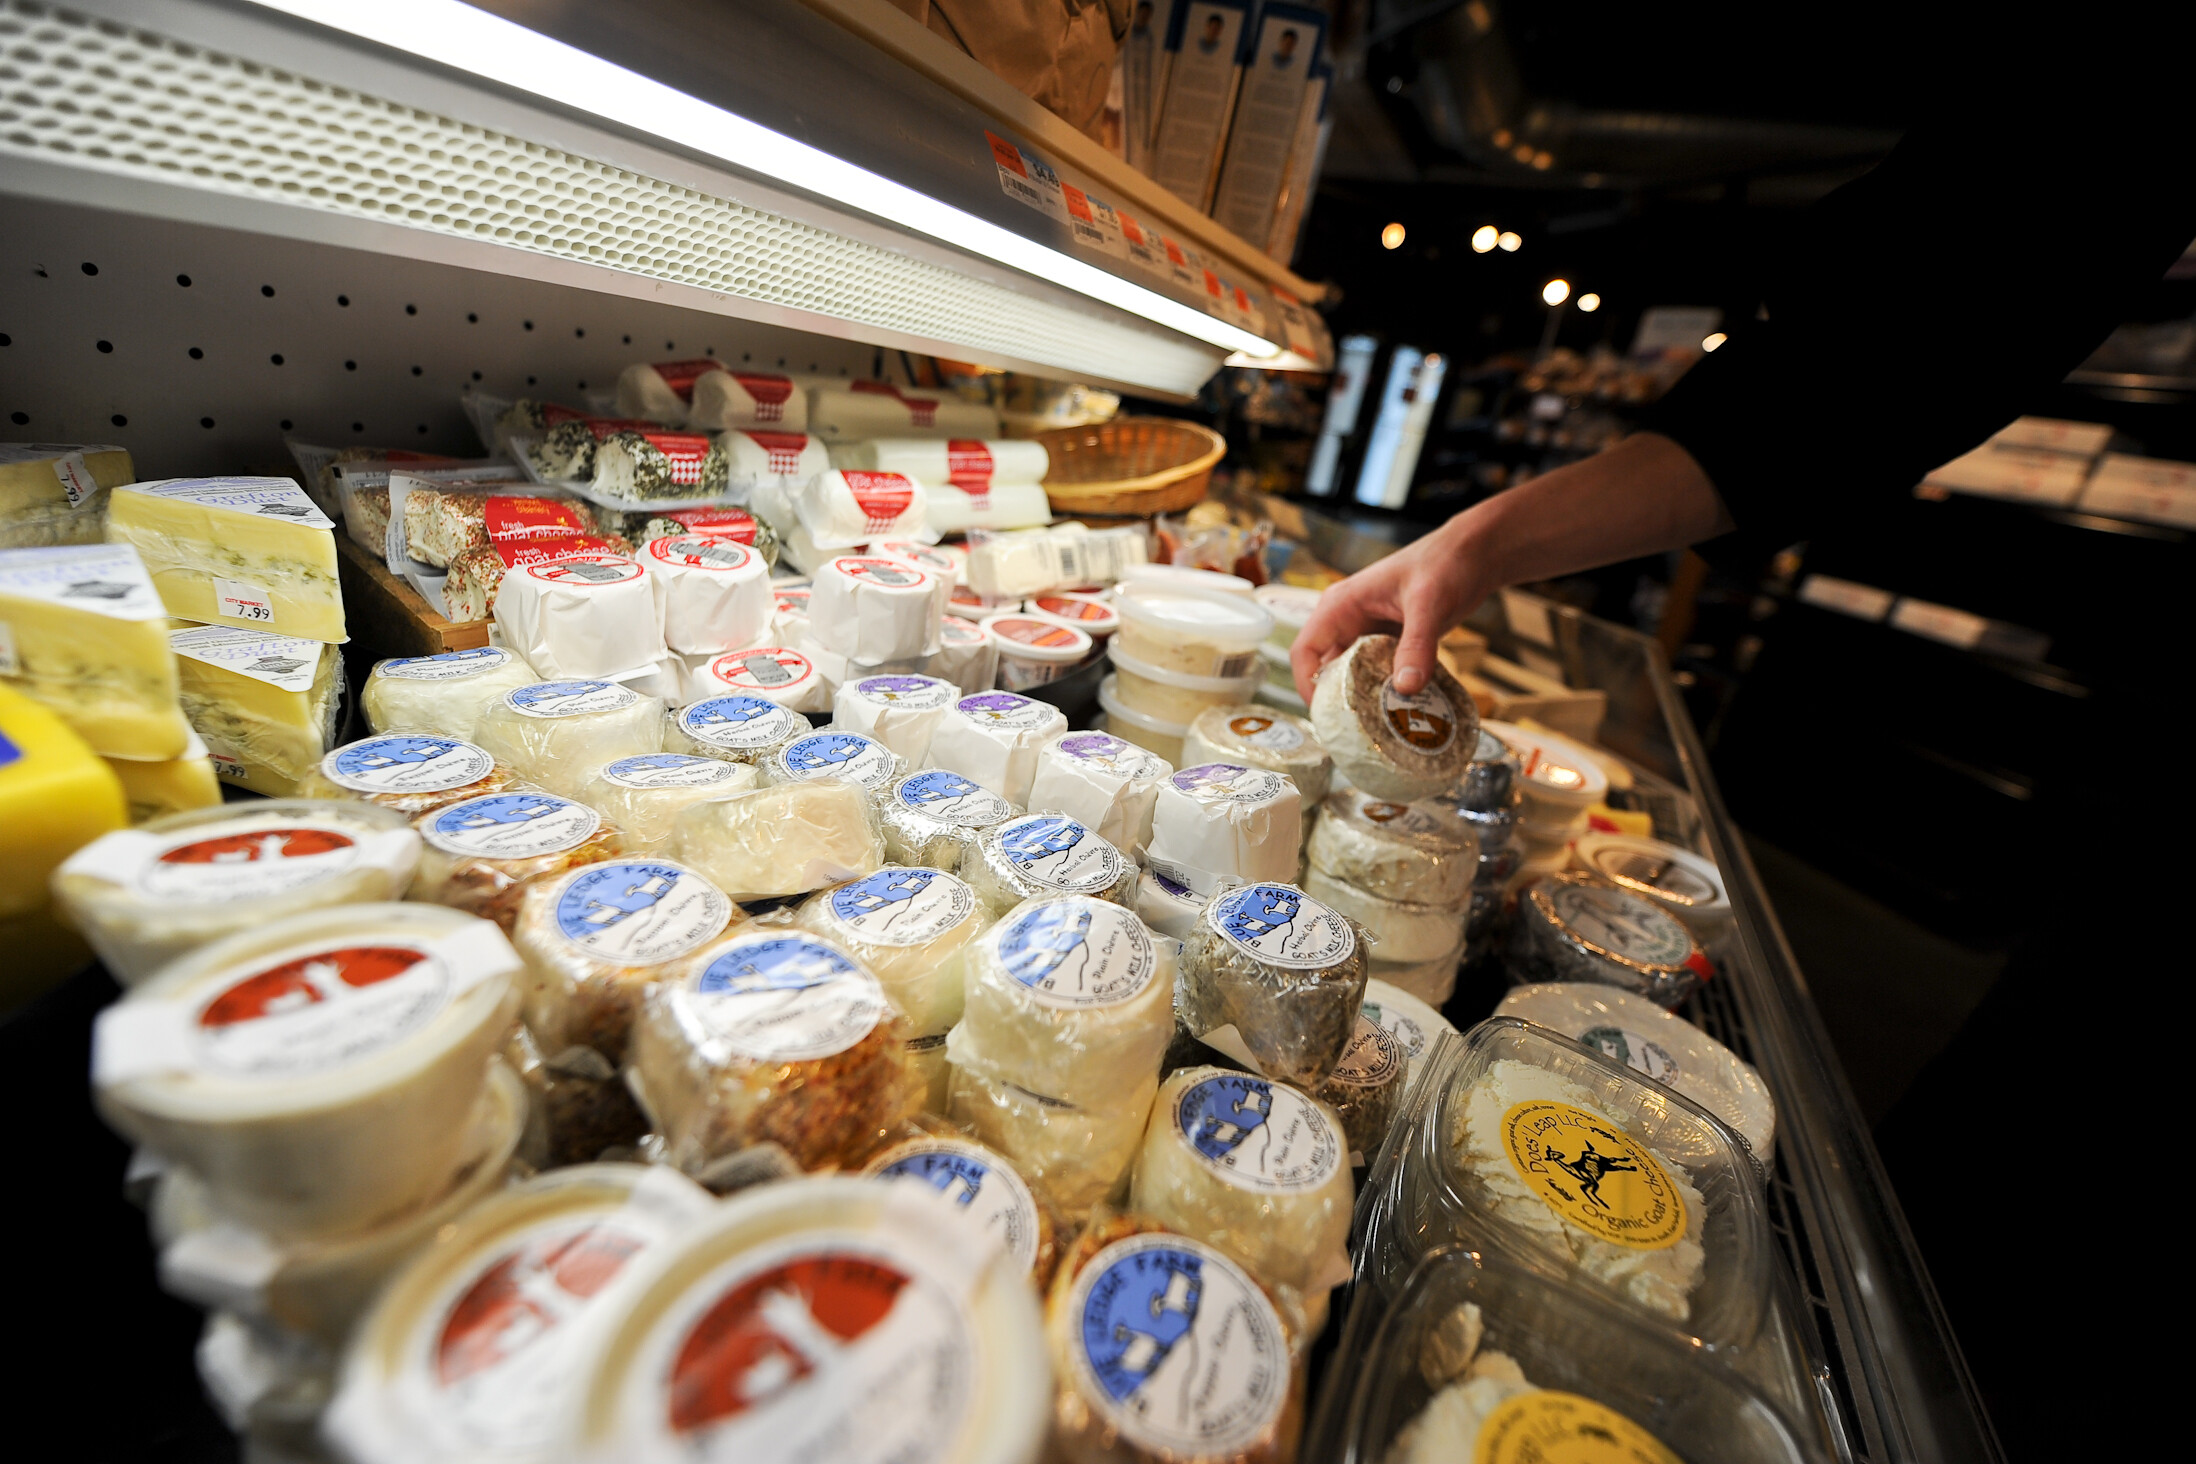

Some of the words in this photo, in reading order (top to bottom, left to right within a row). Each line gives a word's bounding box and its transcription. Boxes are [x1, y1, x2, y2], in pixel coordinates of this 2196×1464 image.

[60, 474, 80, 503] 7.99
[195, 490, 302, 504] Grafton
[220, 496, 290, 506] Duet
[501, 520, 525, 531] fresh
[515, 547, 541, 558] fresh
[555, 546, 610, 560] cheese
[237, 604, 270, 620] 7.99
[239, 599, 264, 607] MARKET
[199, 640, 318, 658] Grafton
[220, 647, 298, 660] Duet
[698, 698, 734, 712] LEDGE
[716, 735, 748, 743] GOAT'S
[750, 734, 768, 742] MILK
[791, 737, 825, 755] LEDGE
[832, 736, 867, 749] FARM
[346, 739, 392, 759] LEDGE
[214, 761, 246, 777] 7.99
[789, 757, 811, 776] BLUE
[443, 773, 466, 785] MILK
[861, 773, 878, 784] MILK
[908, 774, 938, 791] LEDGE
[1100, 846, 1110, 871] CHEESE
[887, 871, 933, 880] FARM
[1057, 860, 1081, 876] Herbal
[565, 870, 615, 909] LEDGE
[623, 865, 681, 880] FARM
[838, 876, 879, 898] LEDGE
[837, 899, 867, 926] BLUE
[935, 913, 957, 928] MILK
[949, 887, 965, 911] CHEESE
[1225, 921, 1262, 948] BLUE
[1254, 889, 1300, 903] FARM
[1320, 913, 1342, 939] CHEESE
[685, 921, 709, 940] MILK
[1116, 918, 1143, 953] CHEESE
[1288, 930, 1310, 950] Herbal
[1325, 939, 1341, 955] MILK
[1291, 950, 1328, 959] GOAT'S
[1092, 958, 1109, 979] Plain
[1126, 954, 1143, 977] MILK
[1093, 976, 1132, 994] GOAT'S
[1371, 1032, 1389, 1060] CHEESE
[1367, 1059, 1387, 1074] MILK
[1217, 1079, 1270, 1094] FARM
[1299, 1107, 1325, 1144] CHEESE
[1523, 1116, 1563, 1137] Leap
[1556, 1113, 1588, 1130] LLC
[1309, 1144, 1327, 1167] MILK
[1521, 1132, 1550, 1174] Does'
[925, 1158, 984, 1177] FARM
[1625, 1147, 1665, 1197] Cheese
[1581, 1203, 1650, 1232] Organic
[1644, 1198, 1666, 1225] Goat
[1135, 1250, 1200, 1274] FARM
